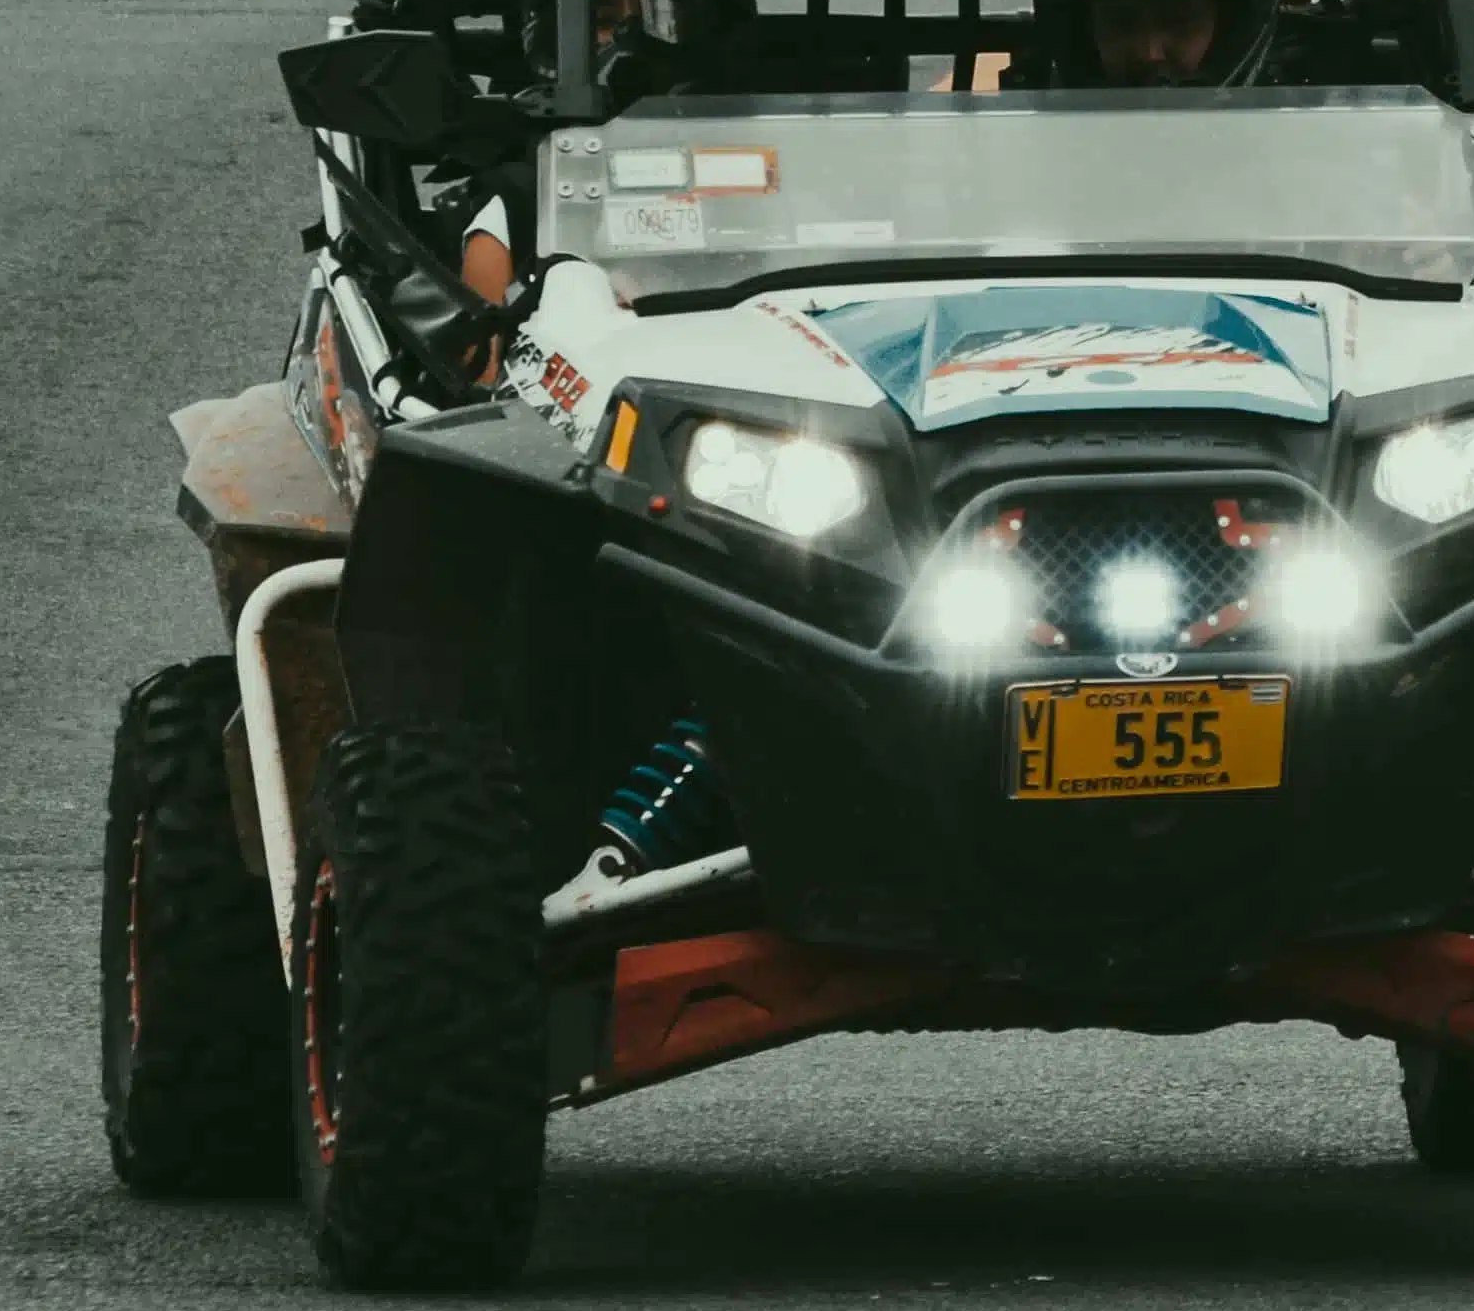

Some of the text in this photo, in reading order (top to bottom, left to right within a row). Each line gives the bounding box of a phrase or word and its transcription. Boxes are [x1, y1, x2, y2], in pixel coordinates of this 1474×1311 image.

[1084, 688, 1213, 708] COSTA RICA
[1113, 710, 1224, 770] 555
[1057, 771, 1231, 794] CENTROAMERICA
